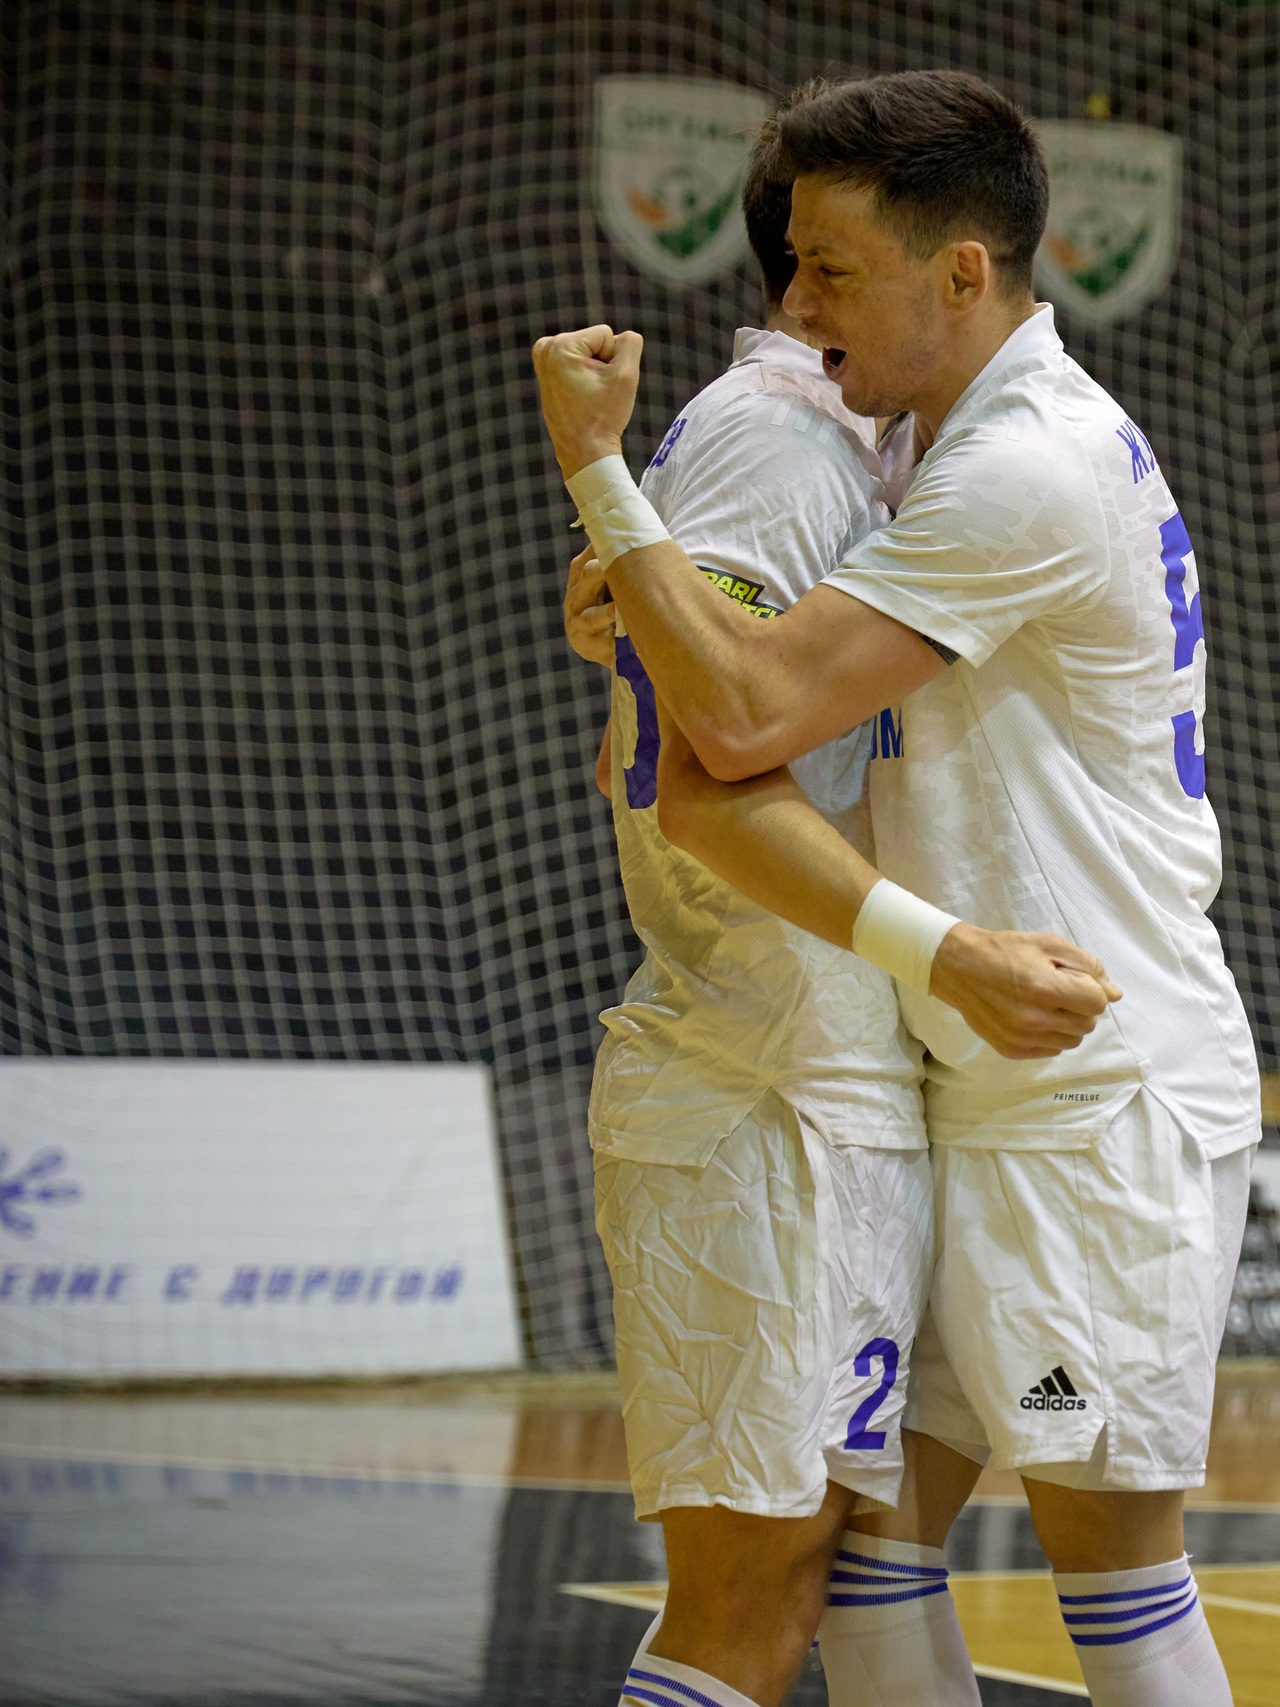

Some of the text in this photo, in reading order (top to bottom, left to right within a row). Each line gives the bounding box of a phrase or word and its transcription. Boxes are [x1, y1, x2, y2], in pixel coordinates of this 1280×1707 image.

[1054, 1093, 1100, 1101] PRIMEBLUE
[221, 1262, 465, 1308] ДОРОГОЙ
[844, 1338, 916, 1450] 2
[1020, 1394, 1086, 1411] adidas
